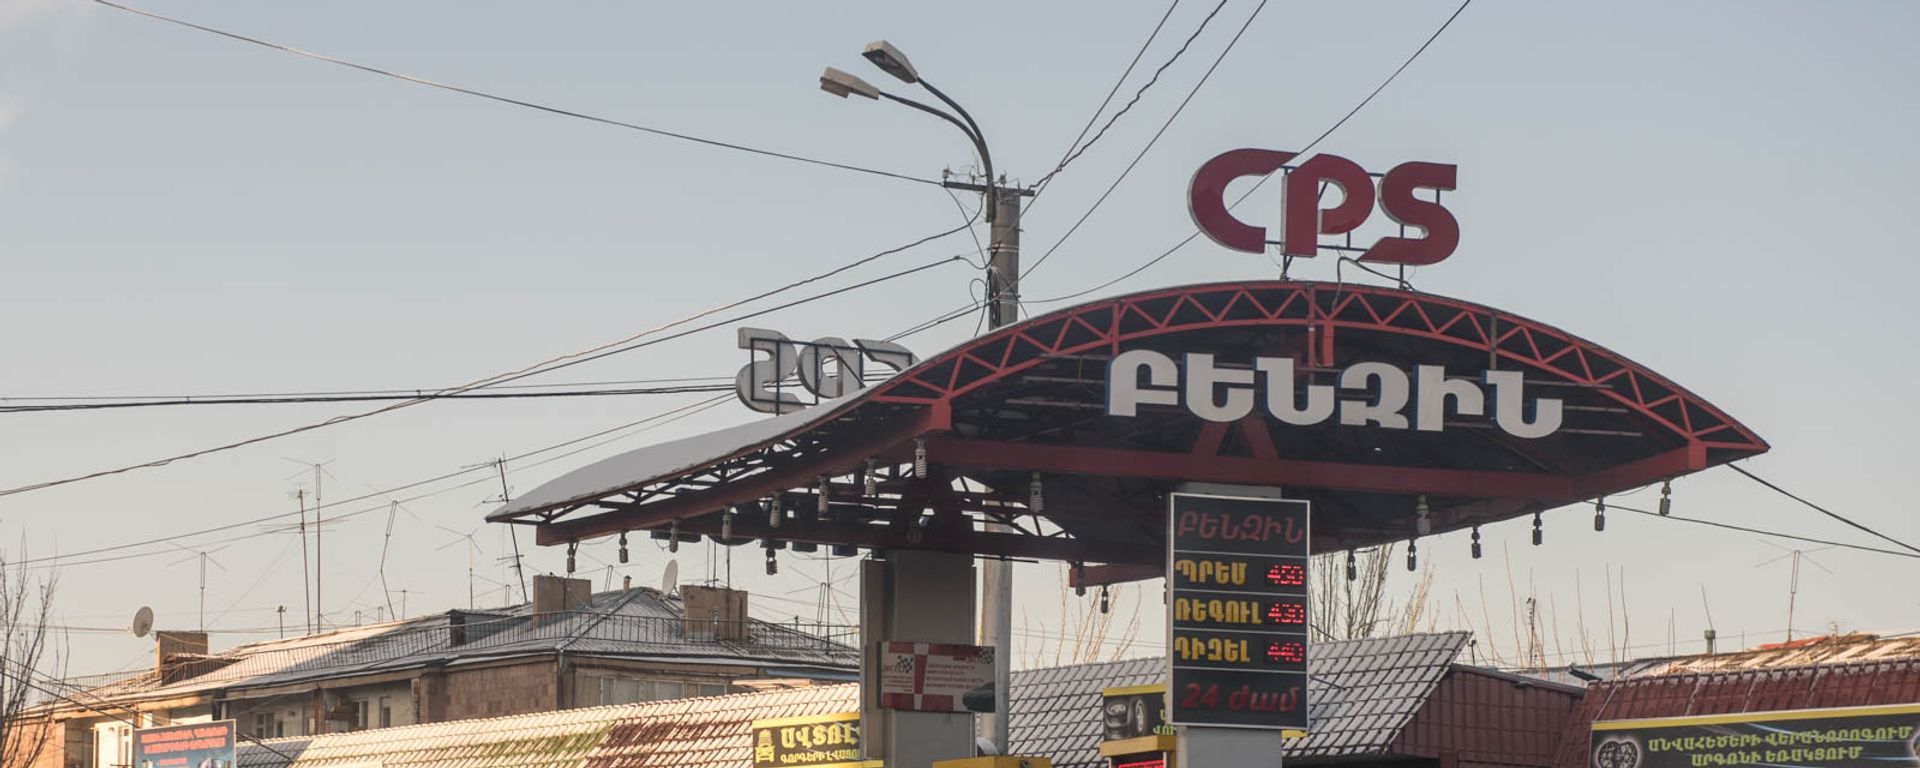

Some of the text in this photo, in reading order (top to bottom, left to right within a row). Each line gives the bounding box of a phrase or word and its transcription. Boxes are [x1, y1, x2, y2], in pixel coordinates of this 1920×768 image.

[1187, 148, 1460, 266] CPS
[1106, 349, 1563, 439] ԲԵՆԶԻՆ
[1177, 509, 1304, 544] ԲԵՆԶԻՆ
[1175, 559, 1304, 585] ՊՐԵՄ 450
[1174, 597, 1304, 625] ՌԵԳՈՒԼ 430
[1174, 636, 1303, 663] ԴԻԶԵԼ 440
[1180, 682, 1219, 709] 24
